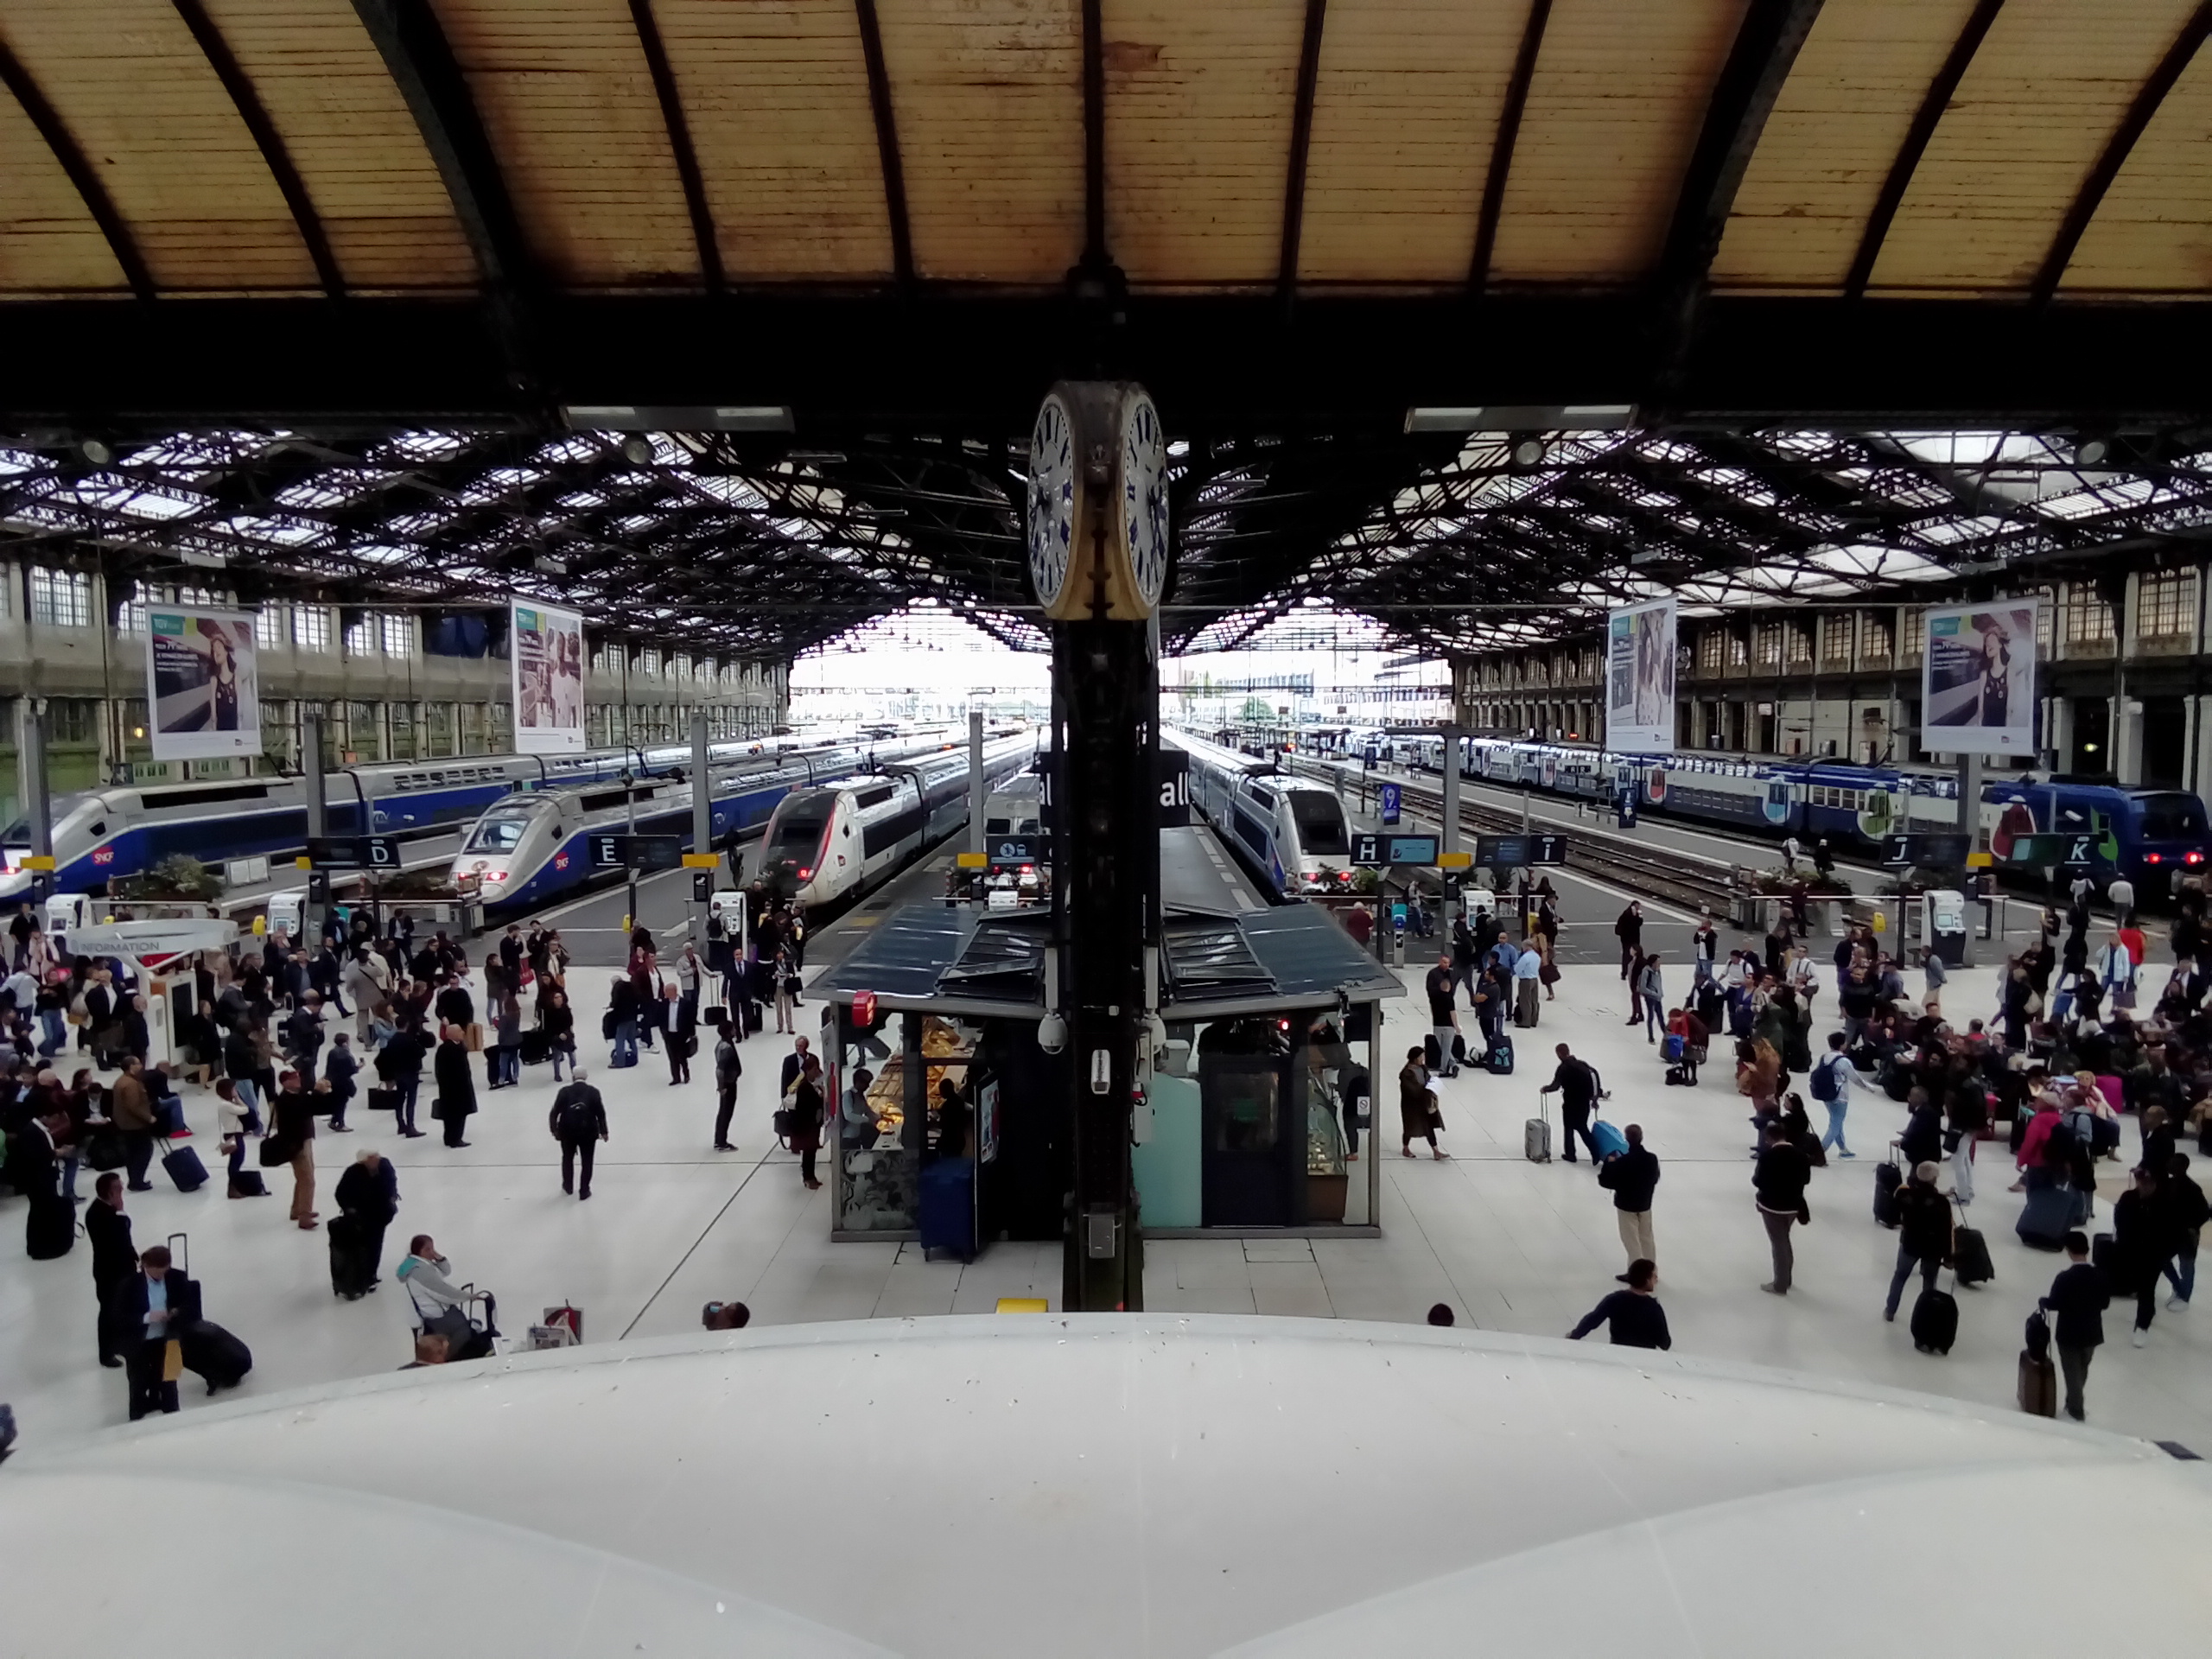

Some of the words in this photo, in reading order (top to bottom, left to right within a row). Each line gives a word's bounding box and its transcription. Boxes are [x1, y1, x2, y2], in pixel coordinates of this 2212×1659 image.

[93, 851, 114, 864] SNCF
[371, 846, 389, 863] D
[601, 844, 617, 862] E
[1359, 843, 1376, 861] H
[1891, 843, 1906, 861] J
[2070, 842, 2088, 861] K
[80, 942, 160, 952] INFORMATION
